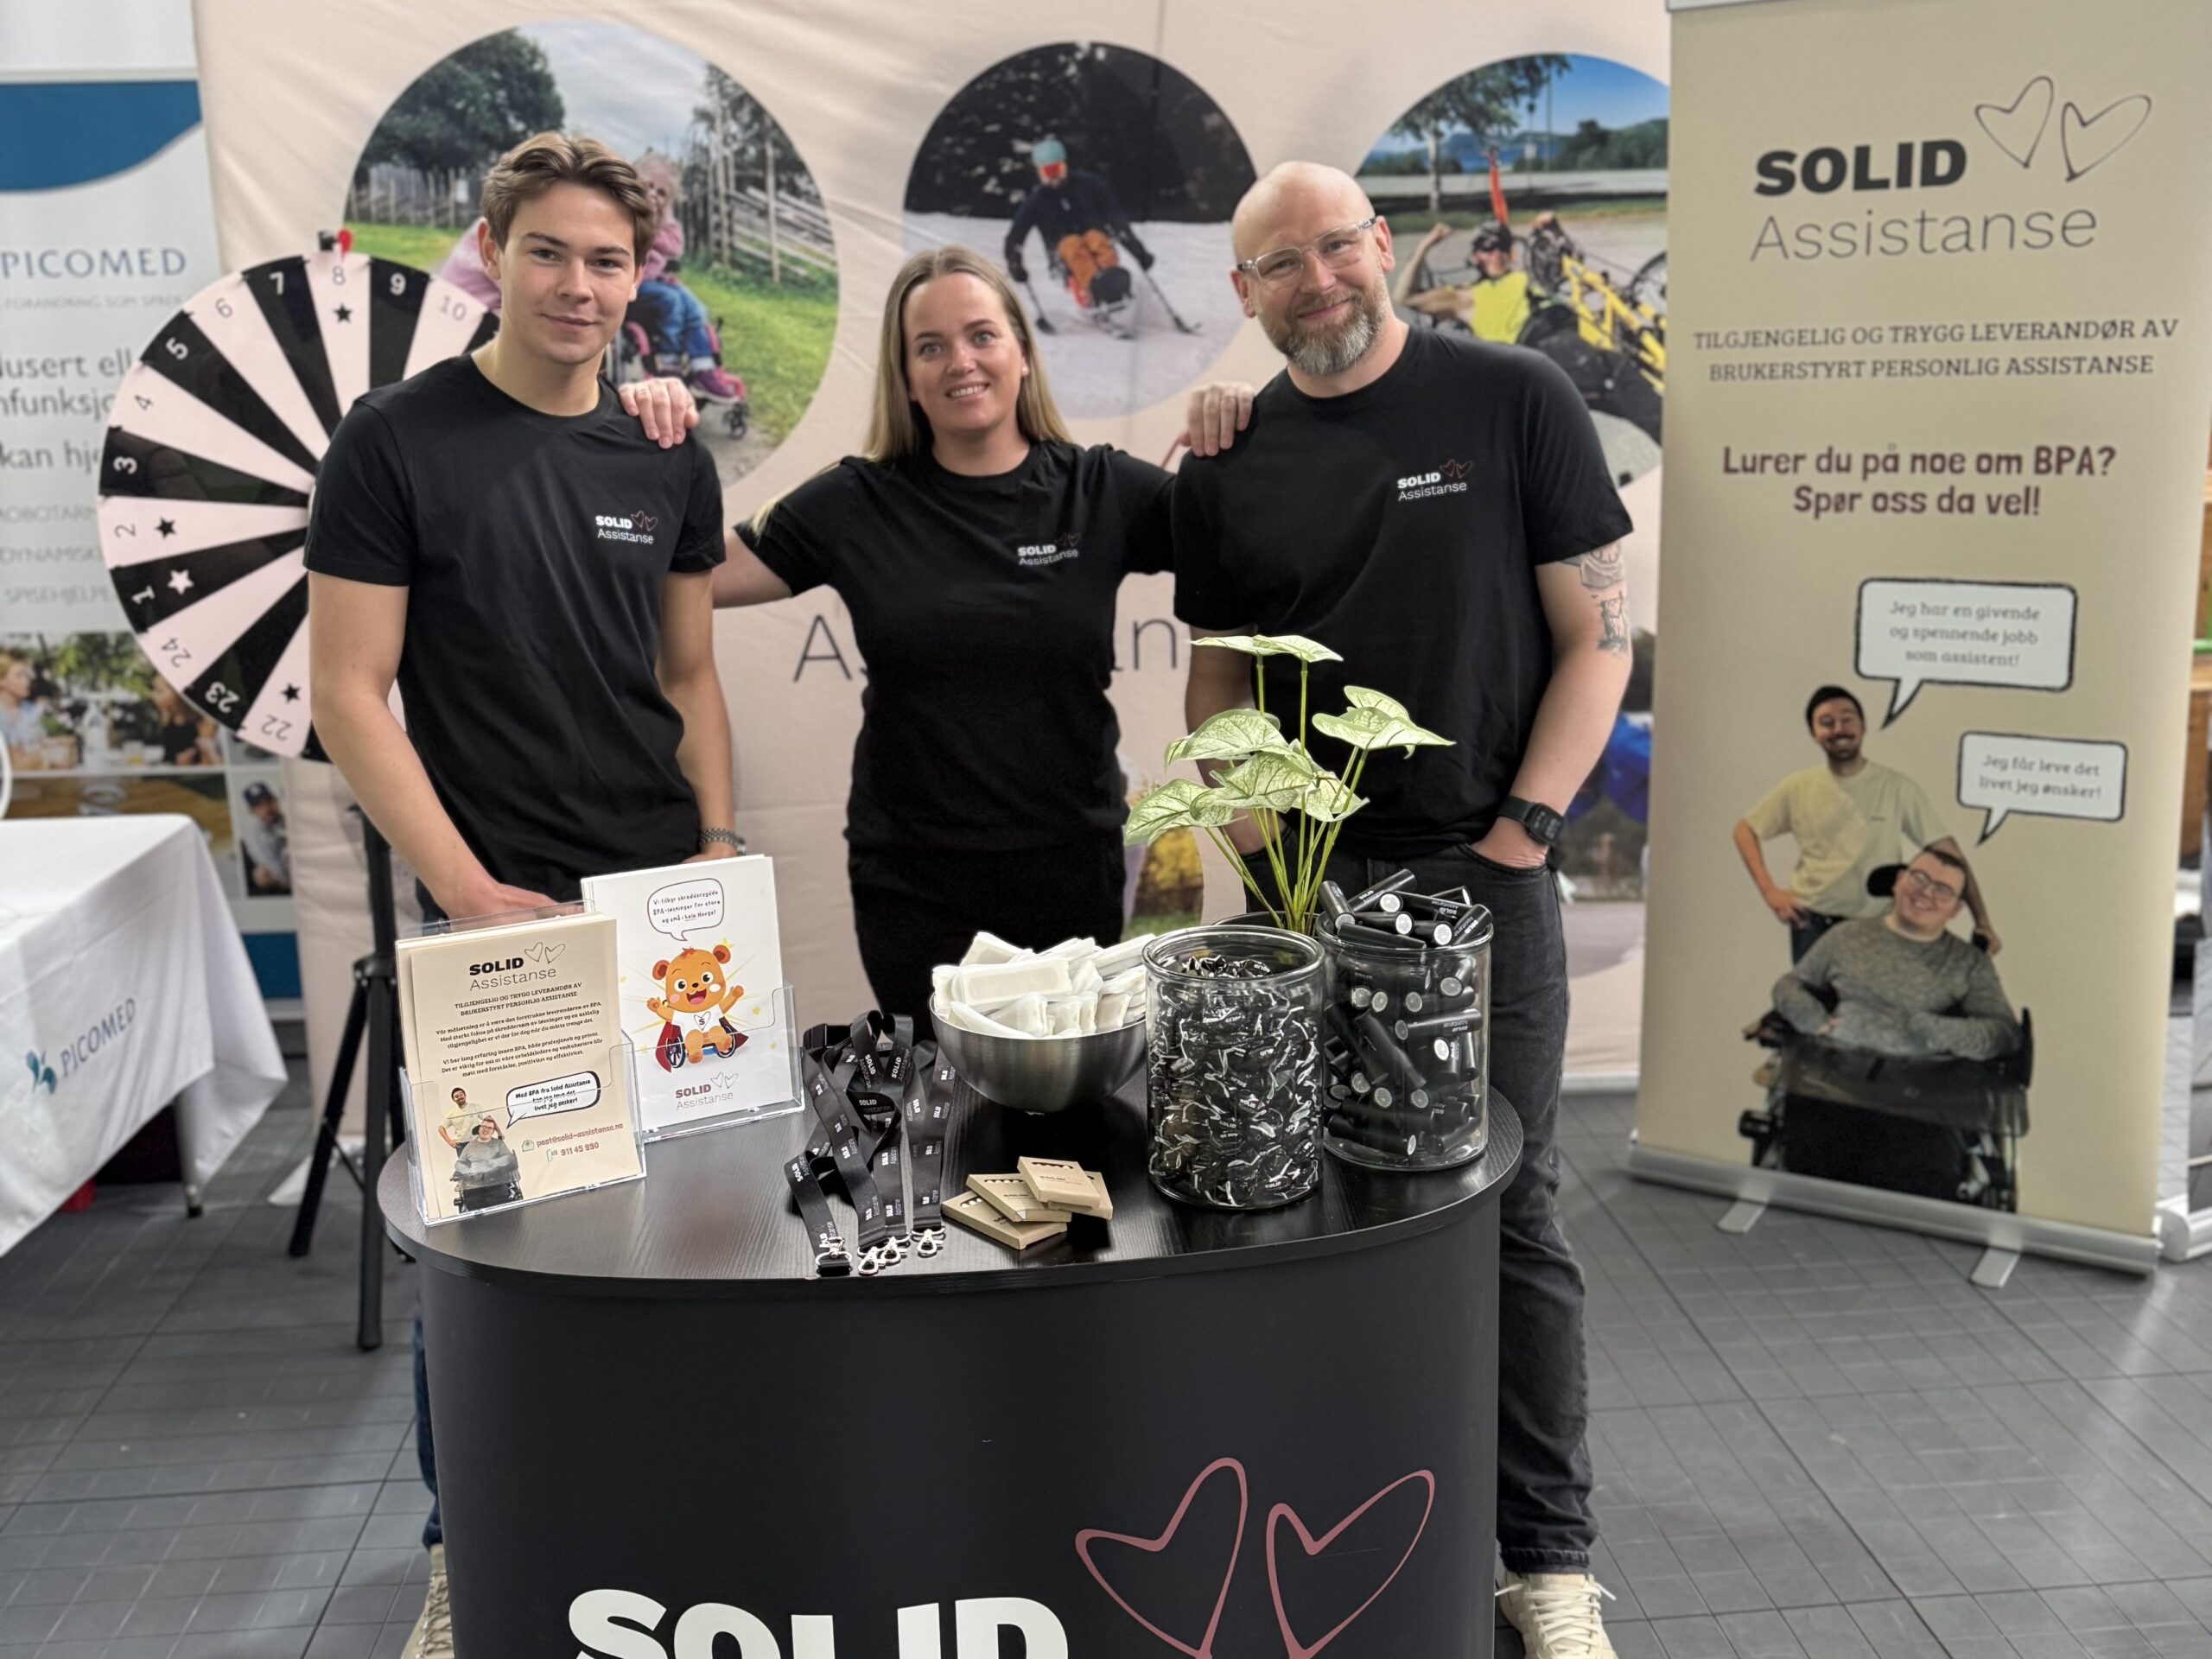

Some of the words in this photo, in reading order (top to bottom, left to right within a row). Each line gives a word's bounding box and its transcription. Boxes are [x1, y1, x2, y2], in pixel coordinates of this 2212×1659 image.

[1754, 139, 1967, 198] SOLID
[1751, 209, 2097, 262] Assistanse
[0, 248, 187, 279] PICOMED
[269, 271, 286, 296] 7
[332, 264, 346, 286] 8
[390, 272, 407, 296] 9
[215, 297, 233, 319] 6
[439, 295, 467, 321] 10
[1693, 327, 1846, 350] TILGJENGELIG
[1851, 326, 1885, 345] OG
[1889, 323, 1965, 344] TRYGG
[1970, 319, 2136, 342] LEVERANDØR
[2141, 318, 2179, 338] AV
[164, 336, 189, 360] 5
[1709, 360, 1866, 382] BRUKERSTYRT
[1870, 358, 2000, 378] PERSONLIG
[2005, 354, 2154, 376] ASSISTANSE
[134, 394, 153, 411] 4
[0, 441, 54, 468] kan
[112, 455, 138, 475] 3
[1723, 445, 1807, 475] Lurer
[1815, 445, 1852, 475] du
[1861, 442, 1901, 482] på
[1910, 451, 1967, 475] noe
[1974, 451, 2024, 475] om
[2033, 445, 2117, 477] BPA?
[1397, 472, 1441, 489] SOLID
[1398, 482, 1467, 501] Assistanse
[1793, 484, 1862, 519] Spør
[1871, 491, 1928, 513] oss
[1936, 485, 1976, 514] da
[1986, 485, 2040, 516] vel!
[113, 524, 136, 538] 2
[595, 515, 632, 529] SOLID
[597, 528, 654, 544] Assistanse
[1017, 543, 1057, 556] SOLID
[1019, 549, 1078, 566] Assistanse
[130, 584, 156, 605] 1
[1889, 601, 1917, 618] Jeg
[1920, 602, 1948, 616] har
[1953, 605, 1973, 617] en
[1975, 604, 2041, 621] givende
[1889, 627, 1909, 640] og
[1912, 626, 1999, 643] spennende
[2001, 629, 2038, 646] jobb
[162, 637, 192, 668] 24
[1905, 650, 1937, 662] som
[204, 681, 241, 714] 23
[260, 714, 293, 741] 22
[2039, 759, 2071, 774] leve
[2075, 761, 2101, 777] det
[2015, 779, 2040, 797] jeg
[469, 957, 524, 976] SOLID
[469, 968, 556, 991] Assistanse
[60, 997, 137, 1078] PICOMED
[864, 1053, 876, 1075] SOLID
[891, 1056, 902, 1079] SOLID
[675, 1084, 712, 1099] SOLID
[677, 1091, 734, 1110] Assistanse
[536, 1123, 624, 1147] post@solid-assistanse.no
[561, 1147, 573, 1156] 911
[574, 1144, 583, 1153] 45
